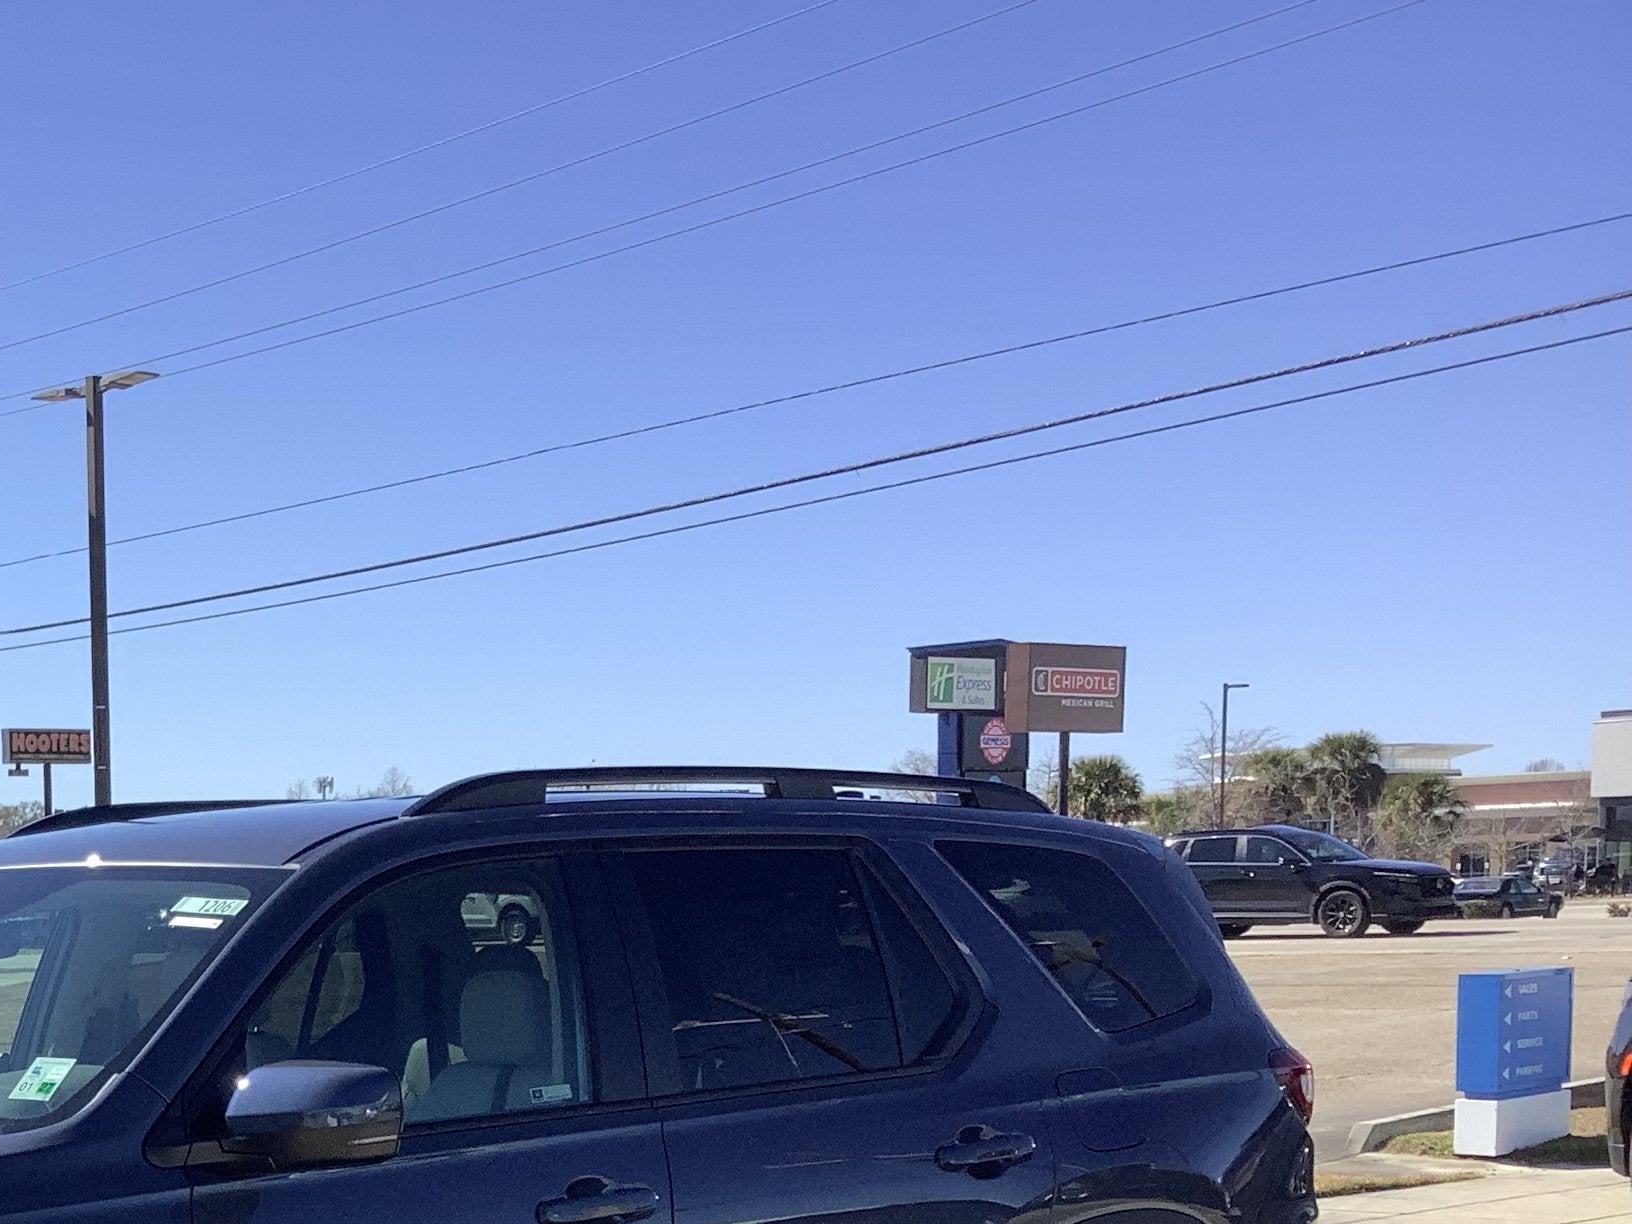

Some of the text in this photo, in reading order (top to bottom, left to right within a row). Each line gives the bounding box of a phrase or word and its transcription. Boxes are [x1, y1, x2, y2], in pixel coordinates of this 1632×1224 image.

[956, 676, 992, 693] Express
[1052, 674, 1116, 691] CHIPOTLE
[1061, 698, 1093, 708] MEXICAN
[11, 732, 89, 753] HOOTERS
[198, 899, 236, 913] 1206
[19, 1081, 57, 1094] 01 27
